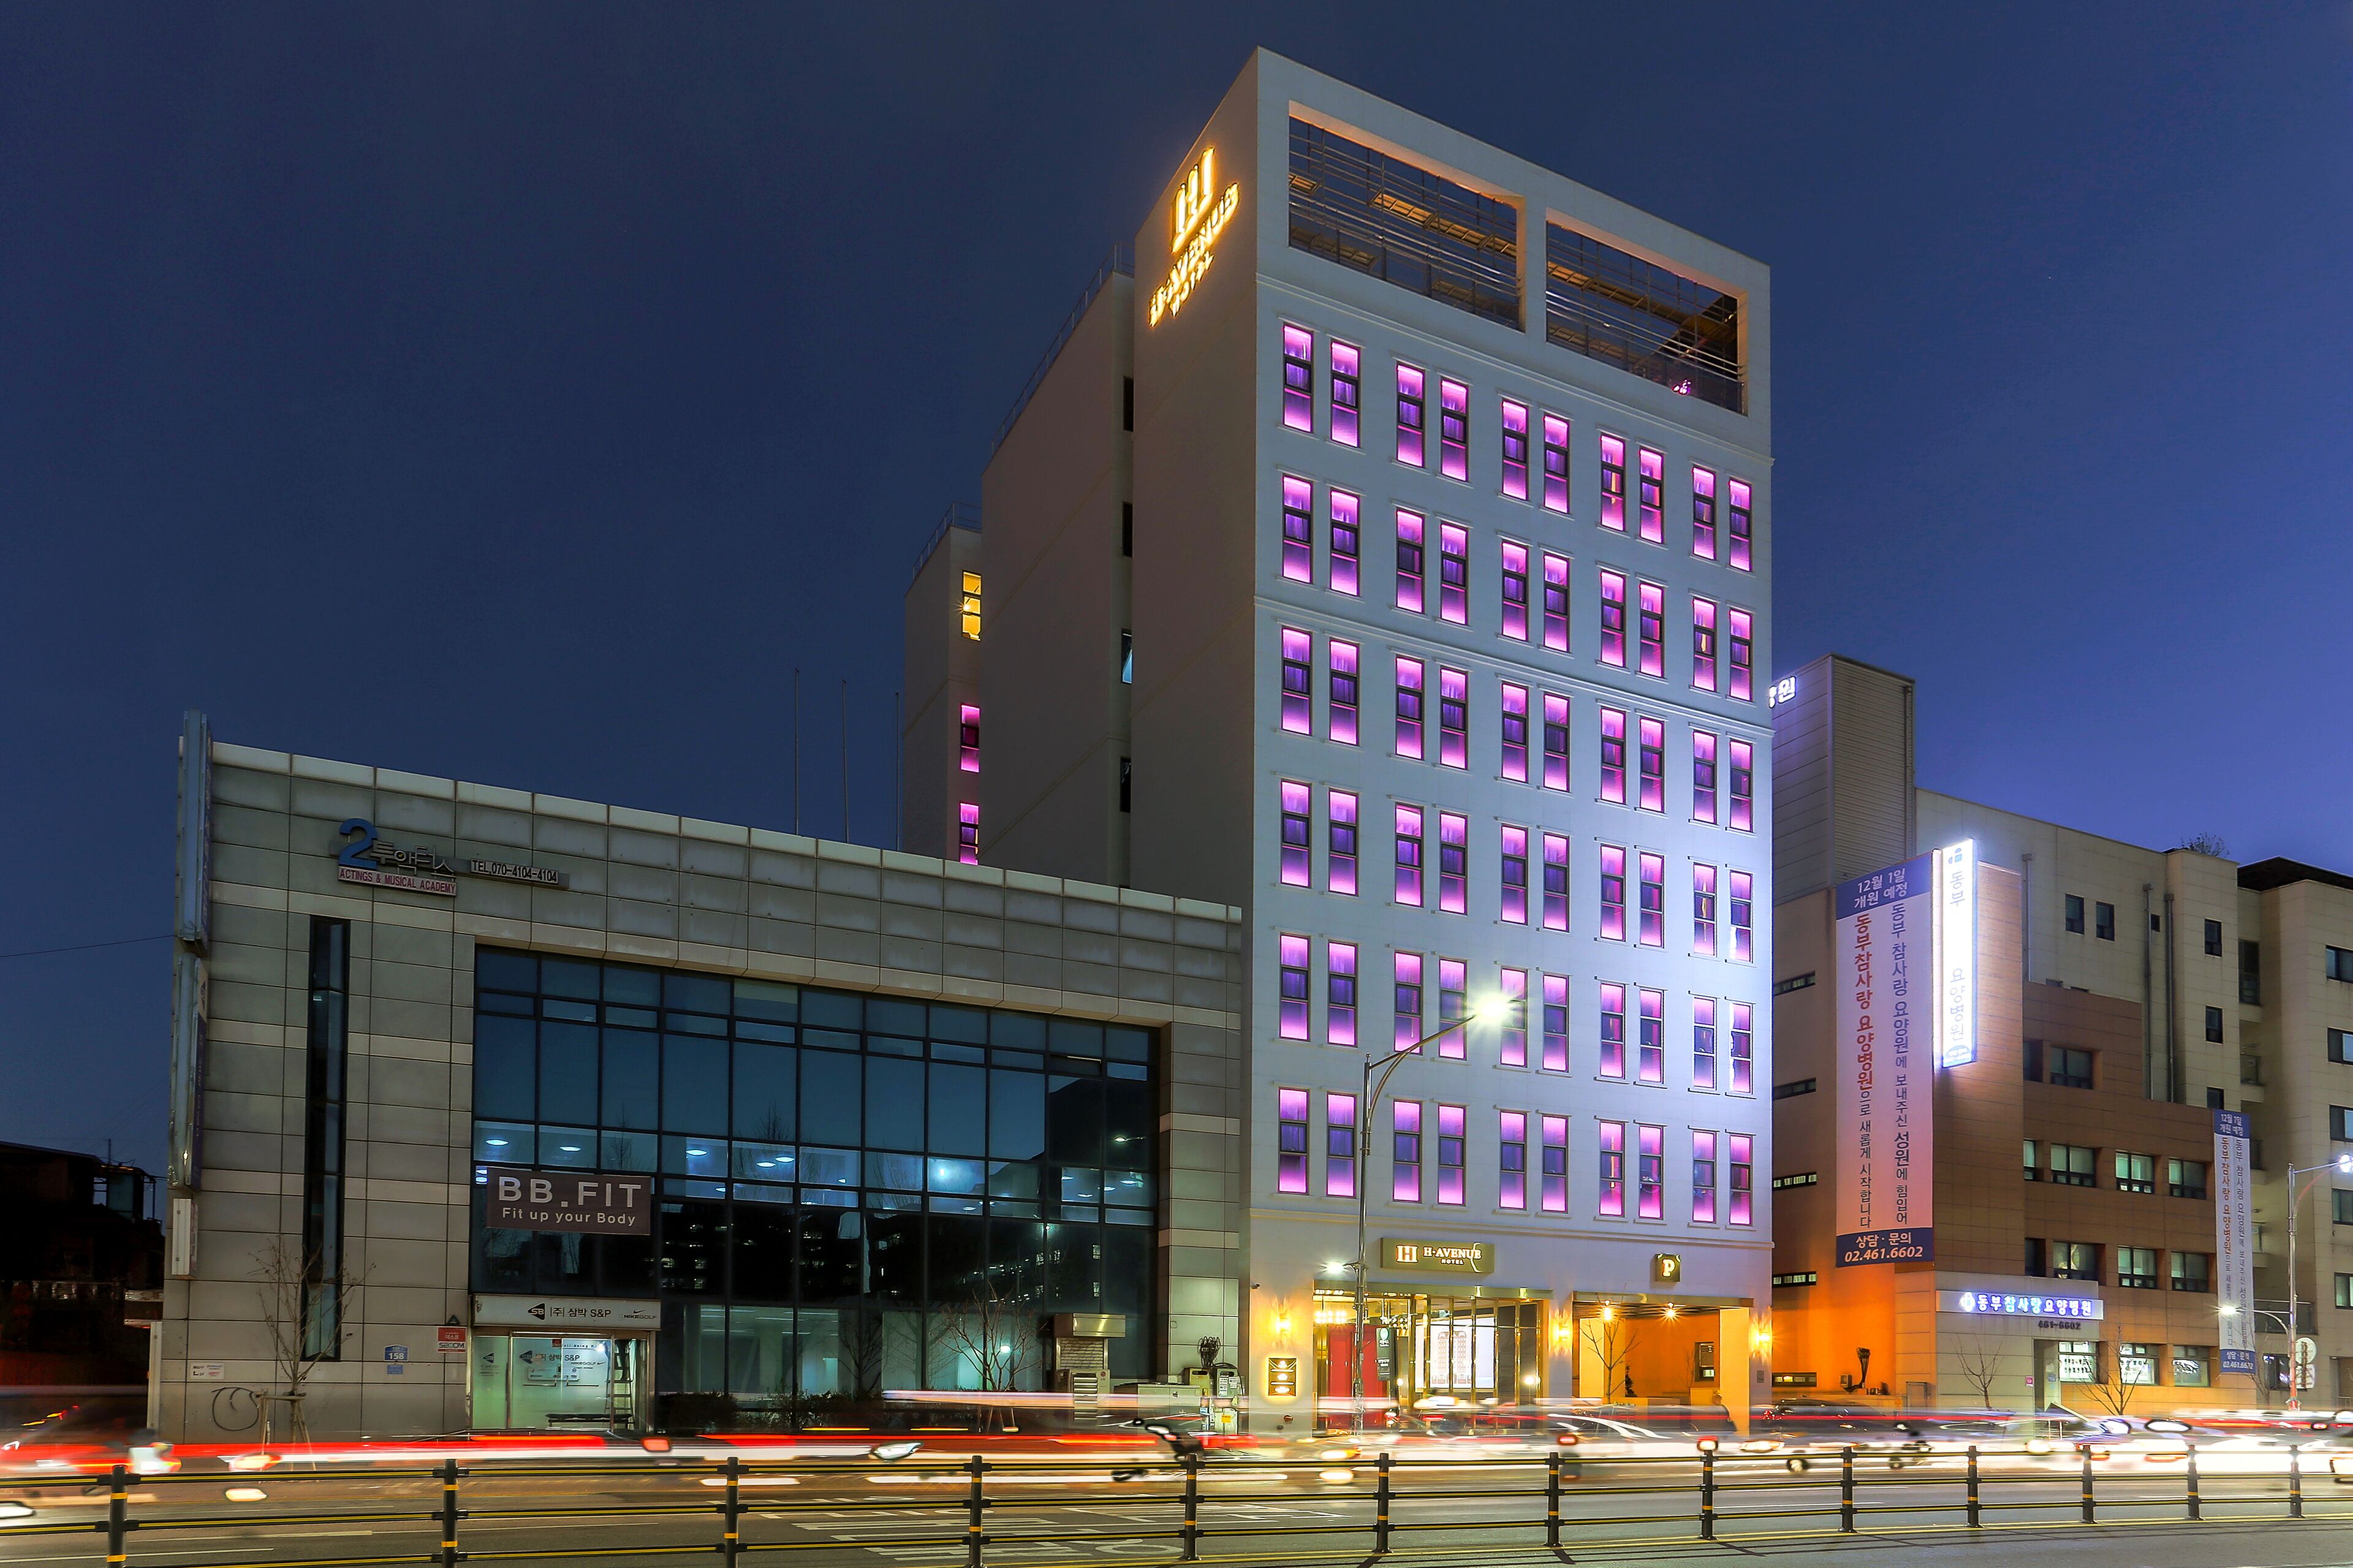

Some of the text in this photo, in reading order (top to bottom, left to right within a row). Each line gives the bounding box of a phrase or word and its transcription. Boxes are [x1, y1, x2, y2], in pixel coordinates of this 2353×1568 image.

[339, 868, 456, 893] ACTINGS & MUSICAL ACADEMY
[1857, 868, 1905, 893] 12월 1일
[1950, 871, 1965, 907] 동부
[1854, 882, 1907, 908] 개원 예정
[1950, 968, 1965, 1041] 요양병원
[1854, 913, 1874, 1229] 동부참사랑 요양병원으로 새롭게 시작합니다
[1891, 903, 1909, 1225] 동부 참사랑 요양원에 보내주신 성원에 힘입어
[498, 1176, 642, 1208] BB.FIT
[502, 1207, 635, 1226] Fit up your Body
[1844, 1246, 1923, 1263] 02.461.6602
[568, 1307, 588, 1318] 삼박
[590, 1309, 612, 1318] S&P
